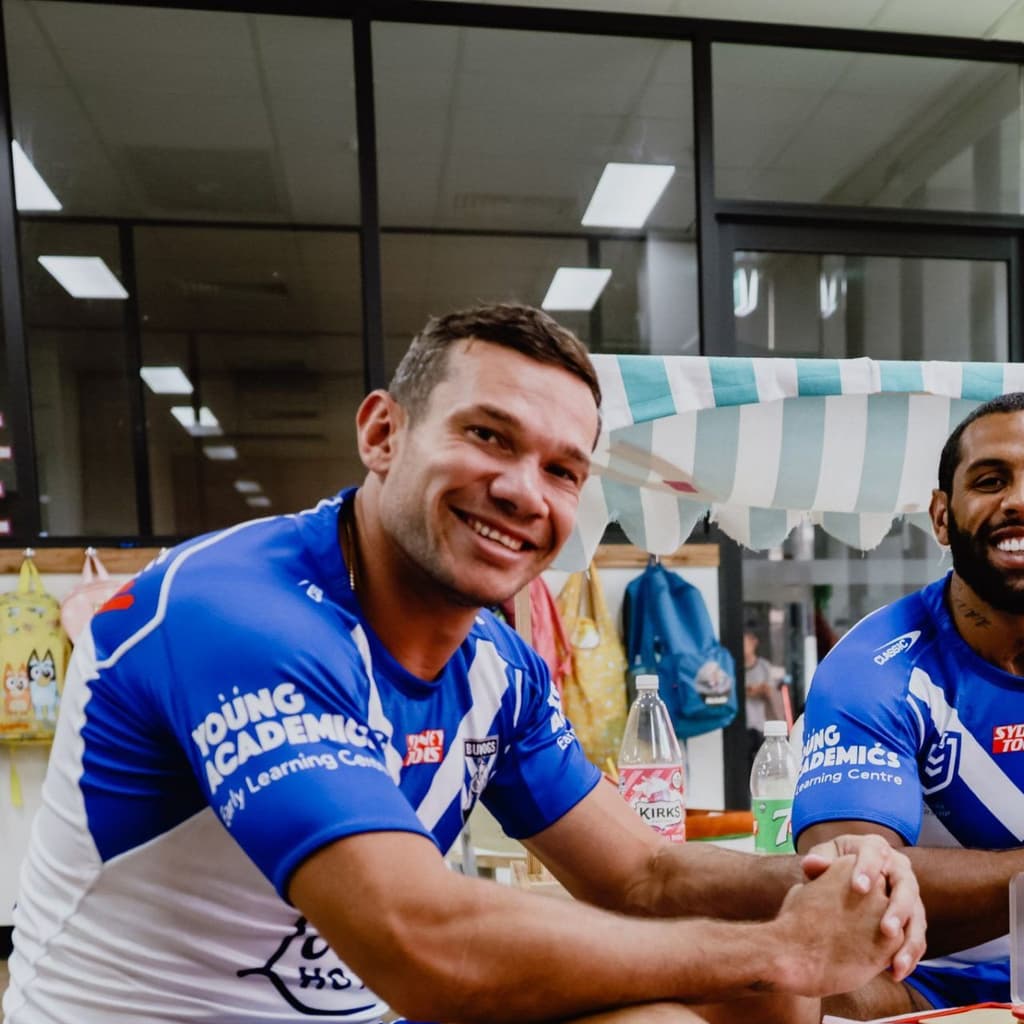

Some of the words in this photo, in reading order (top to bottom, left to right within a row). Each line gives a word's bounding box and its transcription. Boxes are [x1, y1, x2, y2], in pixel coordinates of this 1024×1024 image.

[192, 683, 305, 757] YOUNG
[802, 725, 840, 757] UNG
[245, 752, 338, 793] Learning
[800, 742, 901, 775] ADEMICS
[848, 769, 903, 785] Centre
[639, 806, 681, 820] KIRKS
